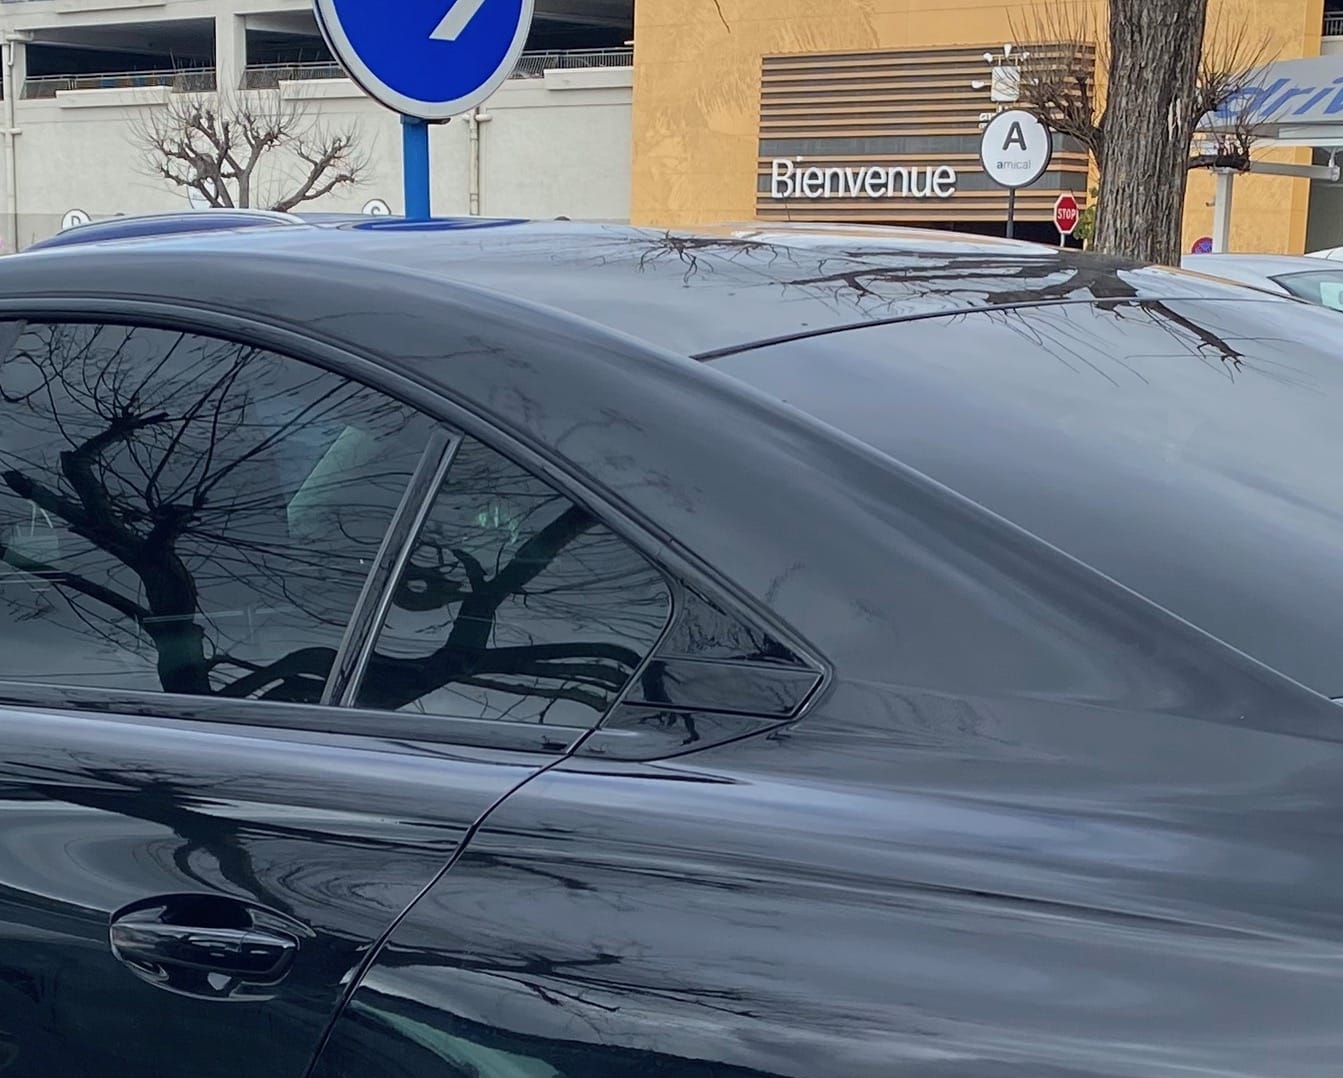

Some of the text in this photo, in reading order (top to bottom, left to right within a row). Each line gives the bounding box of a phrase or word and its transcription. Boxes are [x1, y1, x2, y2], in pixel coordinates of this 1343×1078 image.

[1002, 120, 1027, 150] A
[997, 160, 1031, 169] amical
[771, 155, 956, 198] Bienvenue
[1057, 208, 1076, 220] STOP
